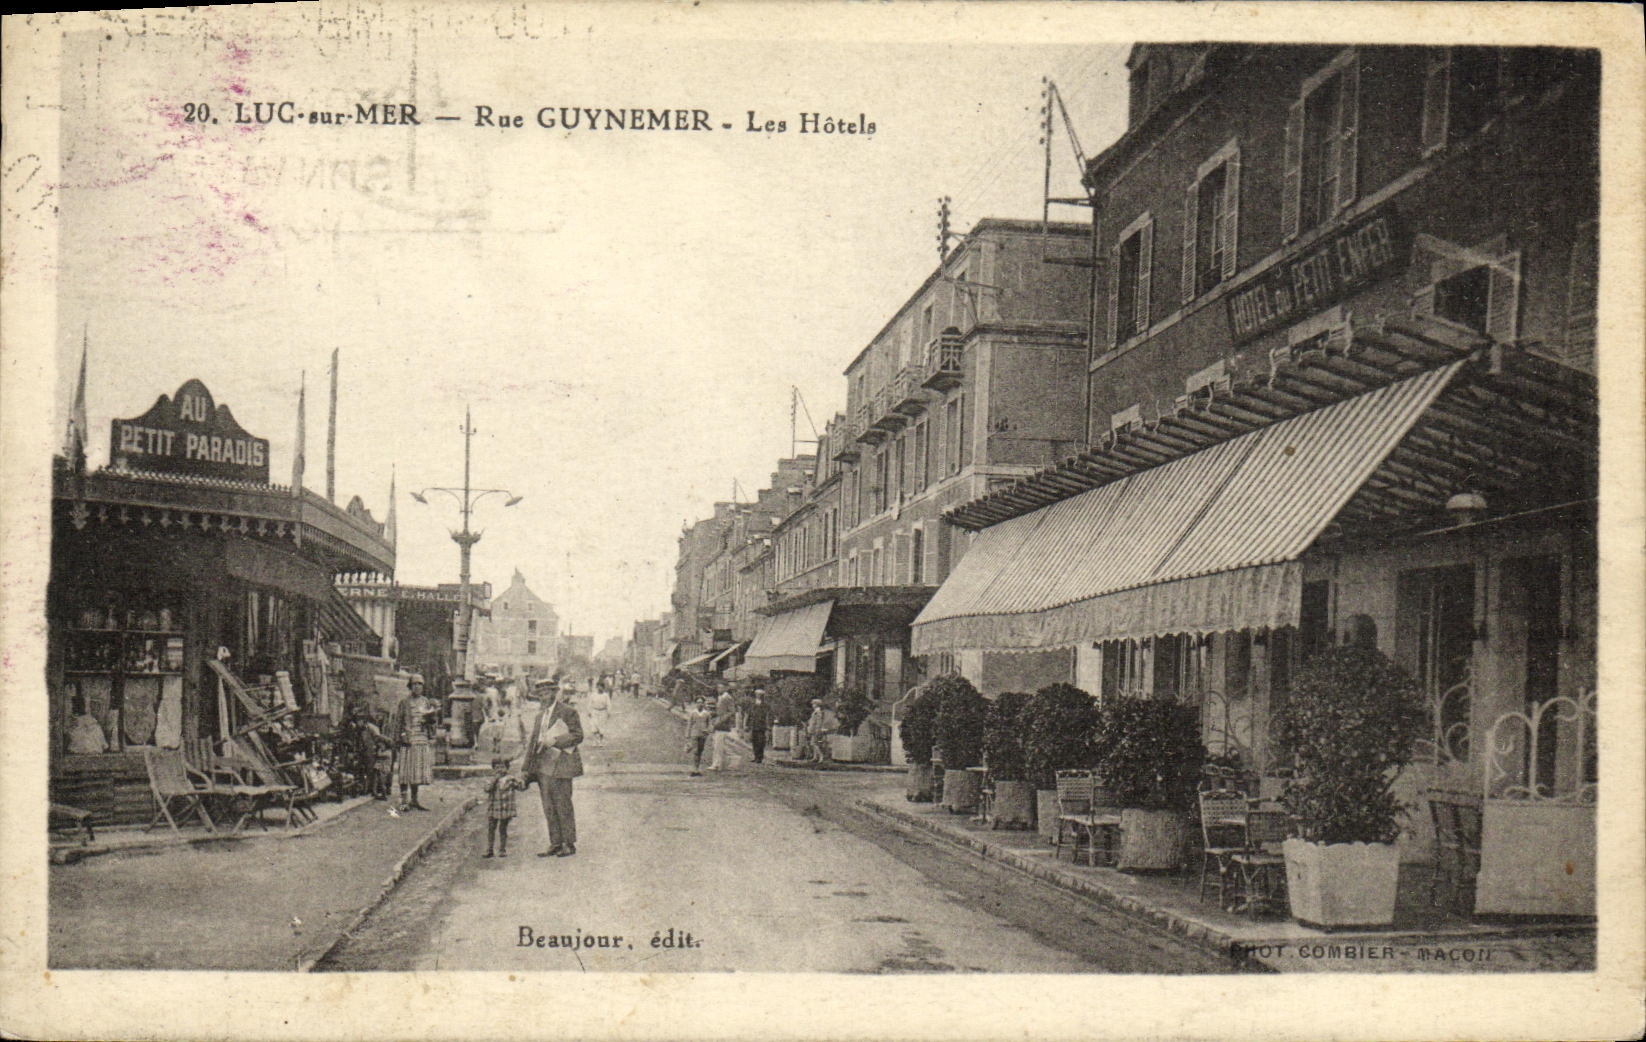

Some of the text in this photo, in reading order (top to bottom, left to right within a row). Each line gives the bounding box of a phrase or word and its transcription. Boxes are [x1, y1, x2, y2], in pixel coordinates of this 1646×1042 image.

[1291, 250, 1335, 306] PETIT
[179, 394, 207, 422] AU
[120, 425, 265, 468] PETIT PARADIS
